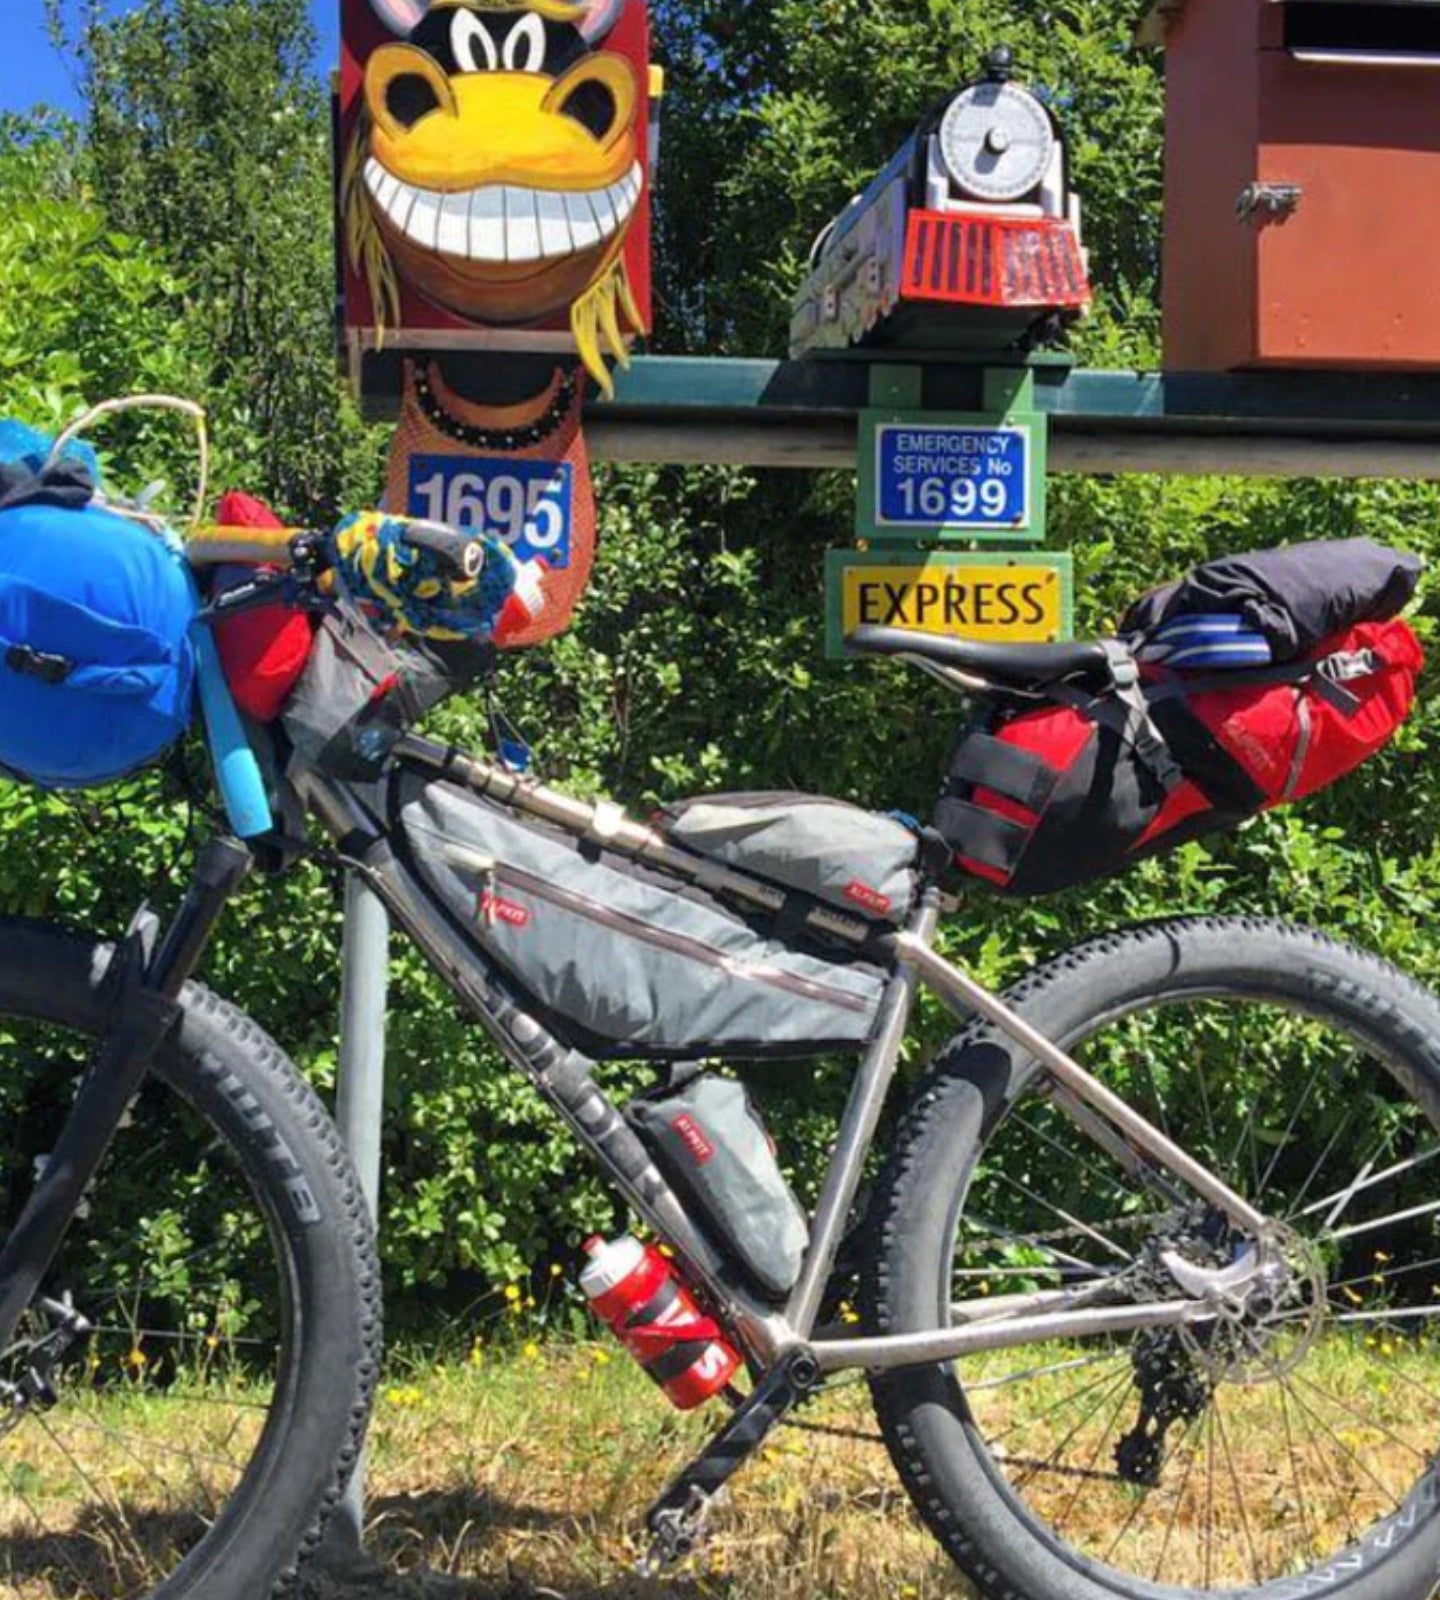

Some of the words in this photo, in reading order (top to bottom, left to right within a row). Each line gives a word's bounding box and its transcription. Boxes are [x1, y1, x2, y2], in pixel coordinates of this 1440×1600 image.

[896, 433, 1009, 454] EMERGENCY
[893, 455, 981, 476] SERVICES
[987, 457, 1013, 476] No
[414, 471, 564, 549] 1695
[896, 476, 1008, 517] 1699
[858, 582, 1045, 625] EXPRESS
